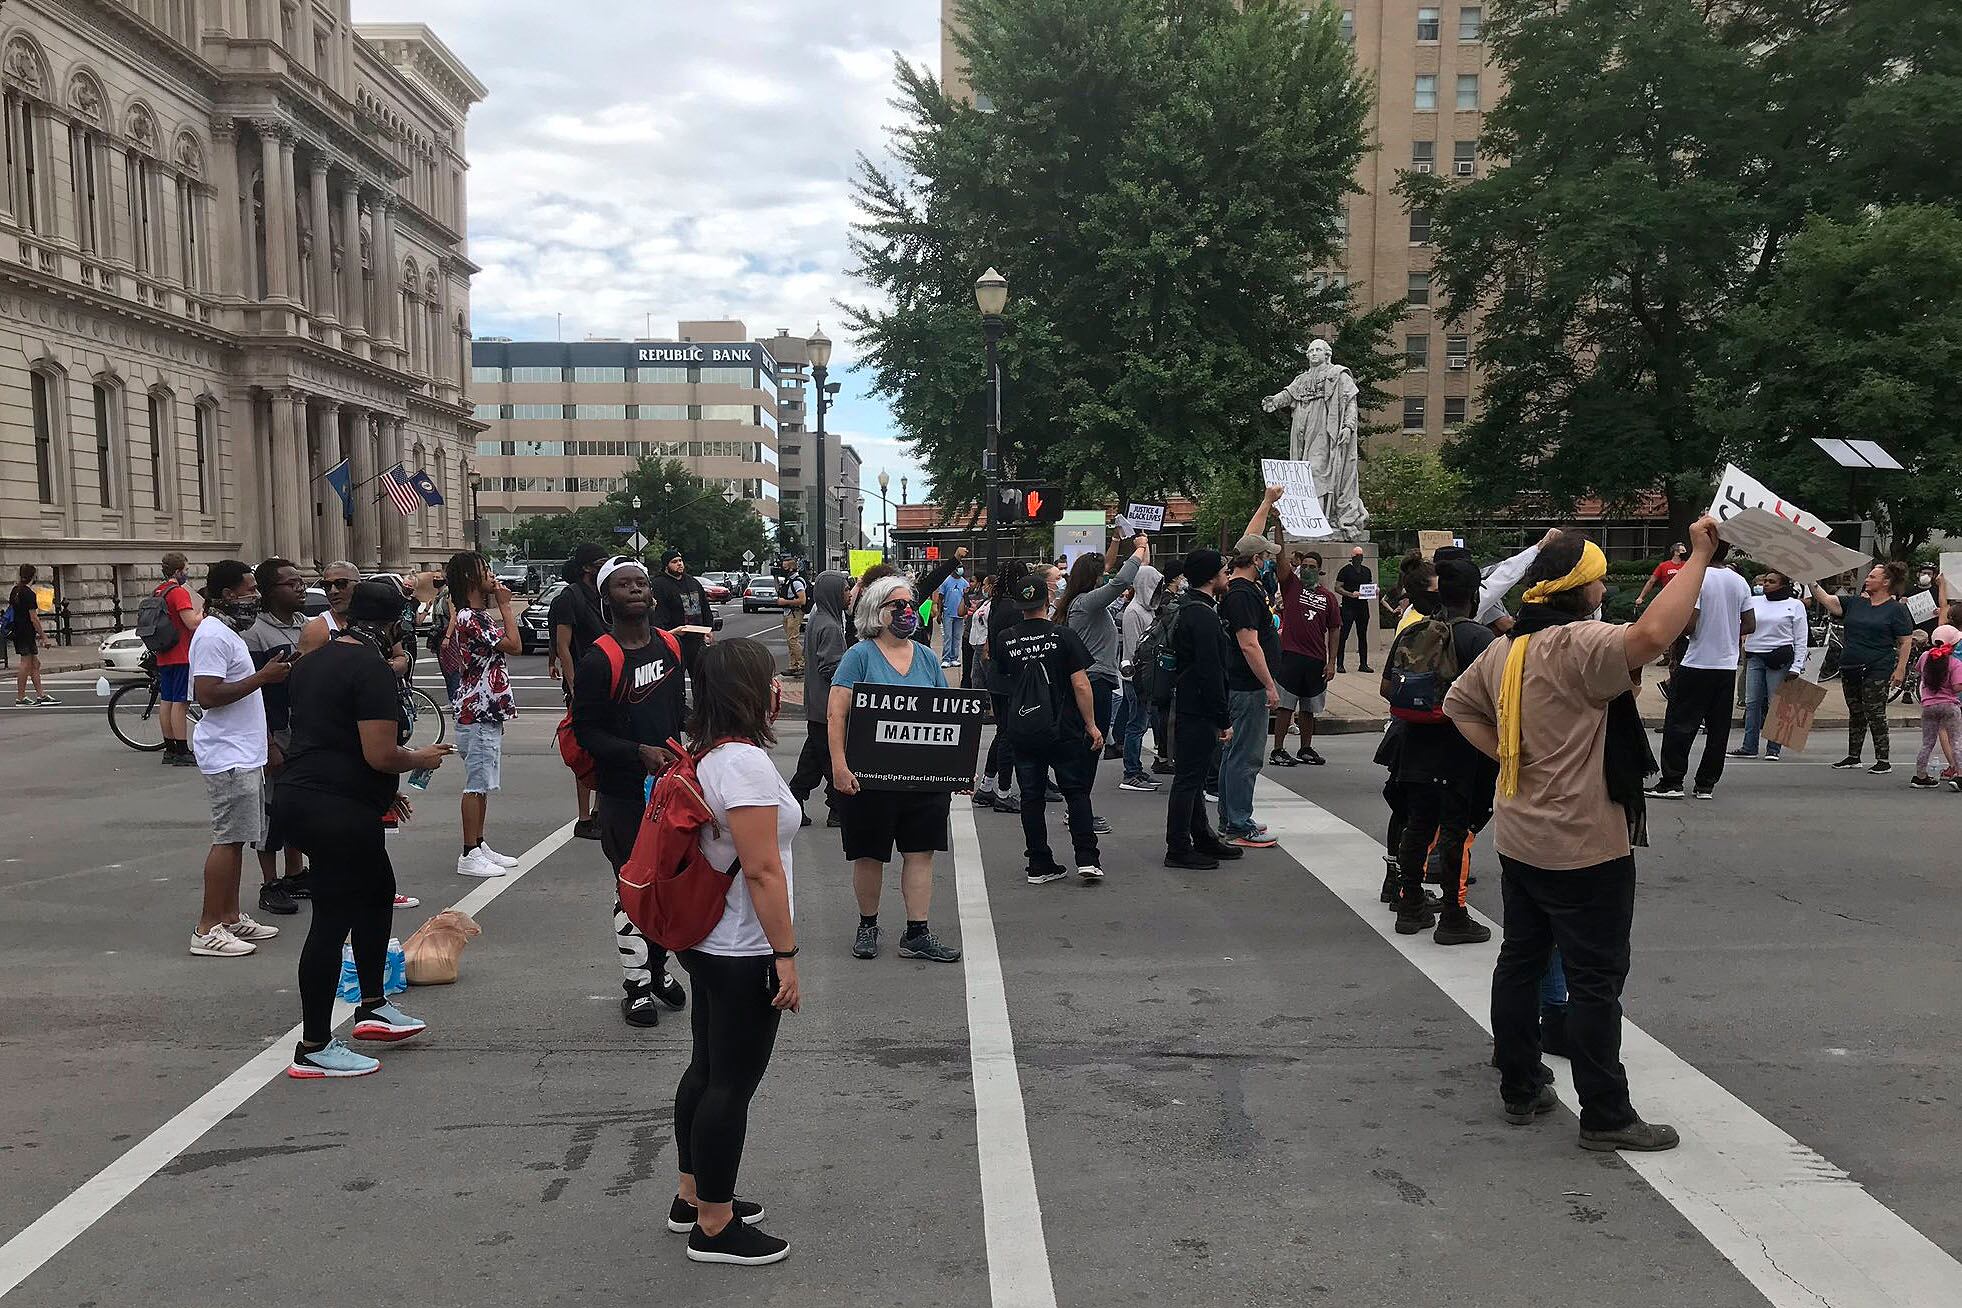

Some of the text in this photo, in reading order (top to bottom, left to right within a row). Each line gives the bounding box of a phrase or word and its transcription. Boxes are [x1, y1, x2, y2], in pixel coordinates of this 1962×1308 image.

[638, 349, 752, 361] REPUBLIC BANK
[1262, 460, 1312, 484] PROPERTY
[1129, 511, 1161, 521] BLACK LIVES
[1133, 506, 1154, 515] JUSTICE
[1280, 516, 1322, 529] CAN NOT
[635, 659, 665, 689] NIKE
[855, 692, 981, 714] BLACK LIVES
[884, 724, 955, 742] MATTER
[854, 771, 970, 783] ShowingUpForRacialJustice.org
